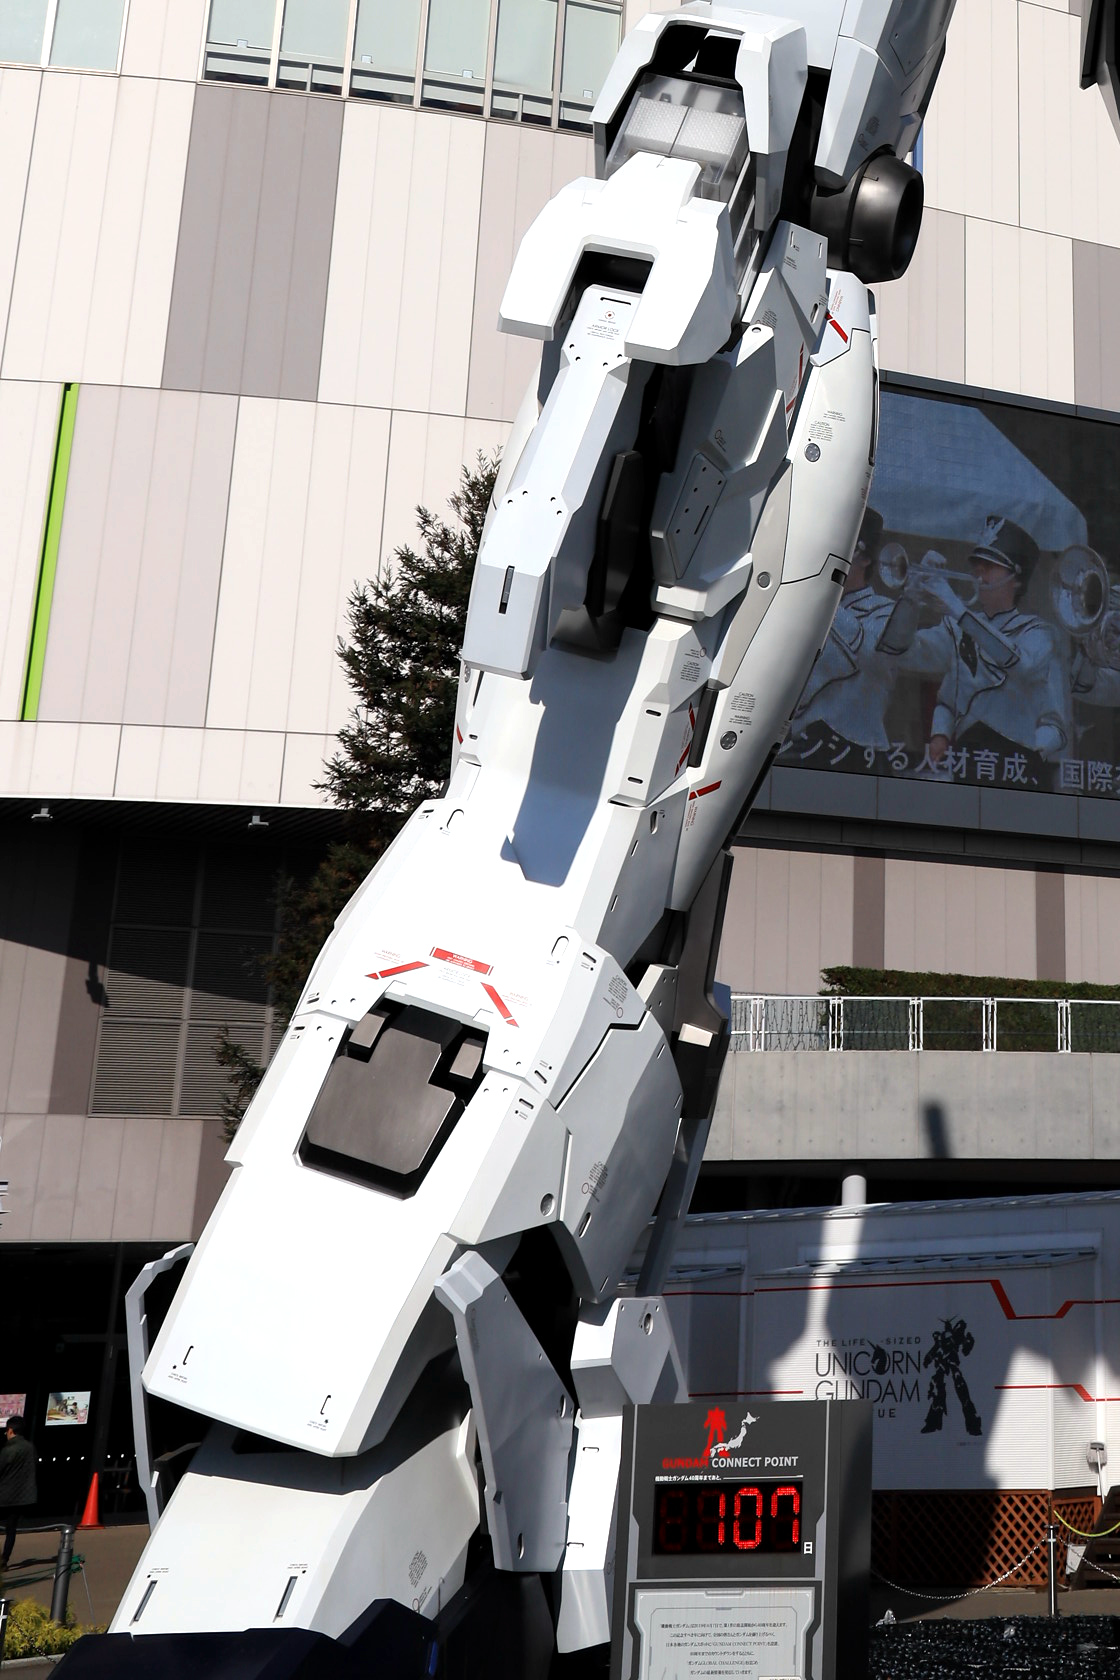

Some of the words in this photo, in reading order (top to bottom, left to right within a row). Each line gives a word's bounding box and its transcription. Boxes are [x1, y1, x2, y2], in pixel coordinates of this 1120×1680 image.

[816, 1339, 837, 1347] THE
[842, 1338, 865, 1346] LIFE
[815, 1350, 921, 1376] UNICORN
[815, 1379, 921, 1403] GUNDAM
[662, 1457, 709, 1468] GUNDAM
[711, 1457, 761, 1468] CONNECT
[764, 1456, 798, 1467] POINT
[718, 1485, 800, 1550] 107
[803, 1541, 813, 1554] 日
